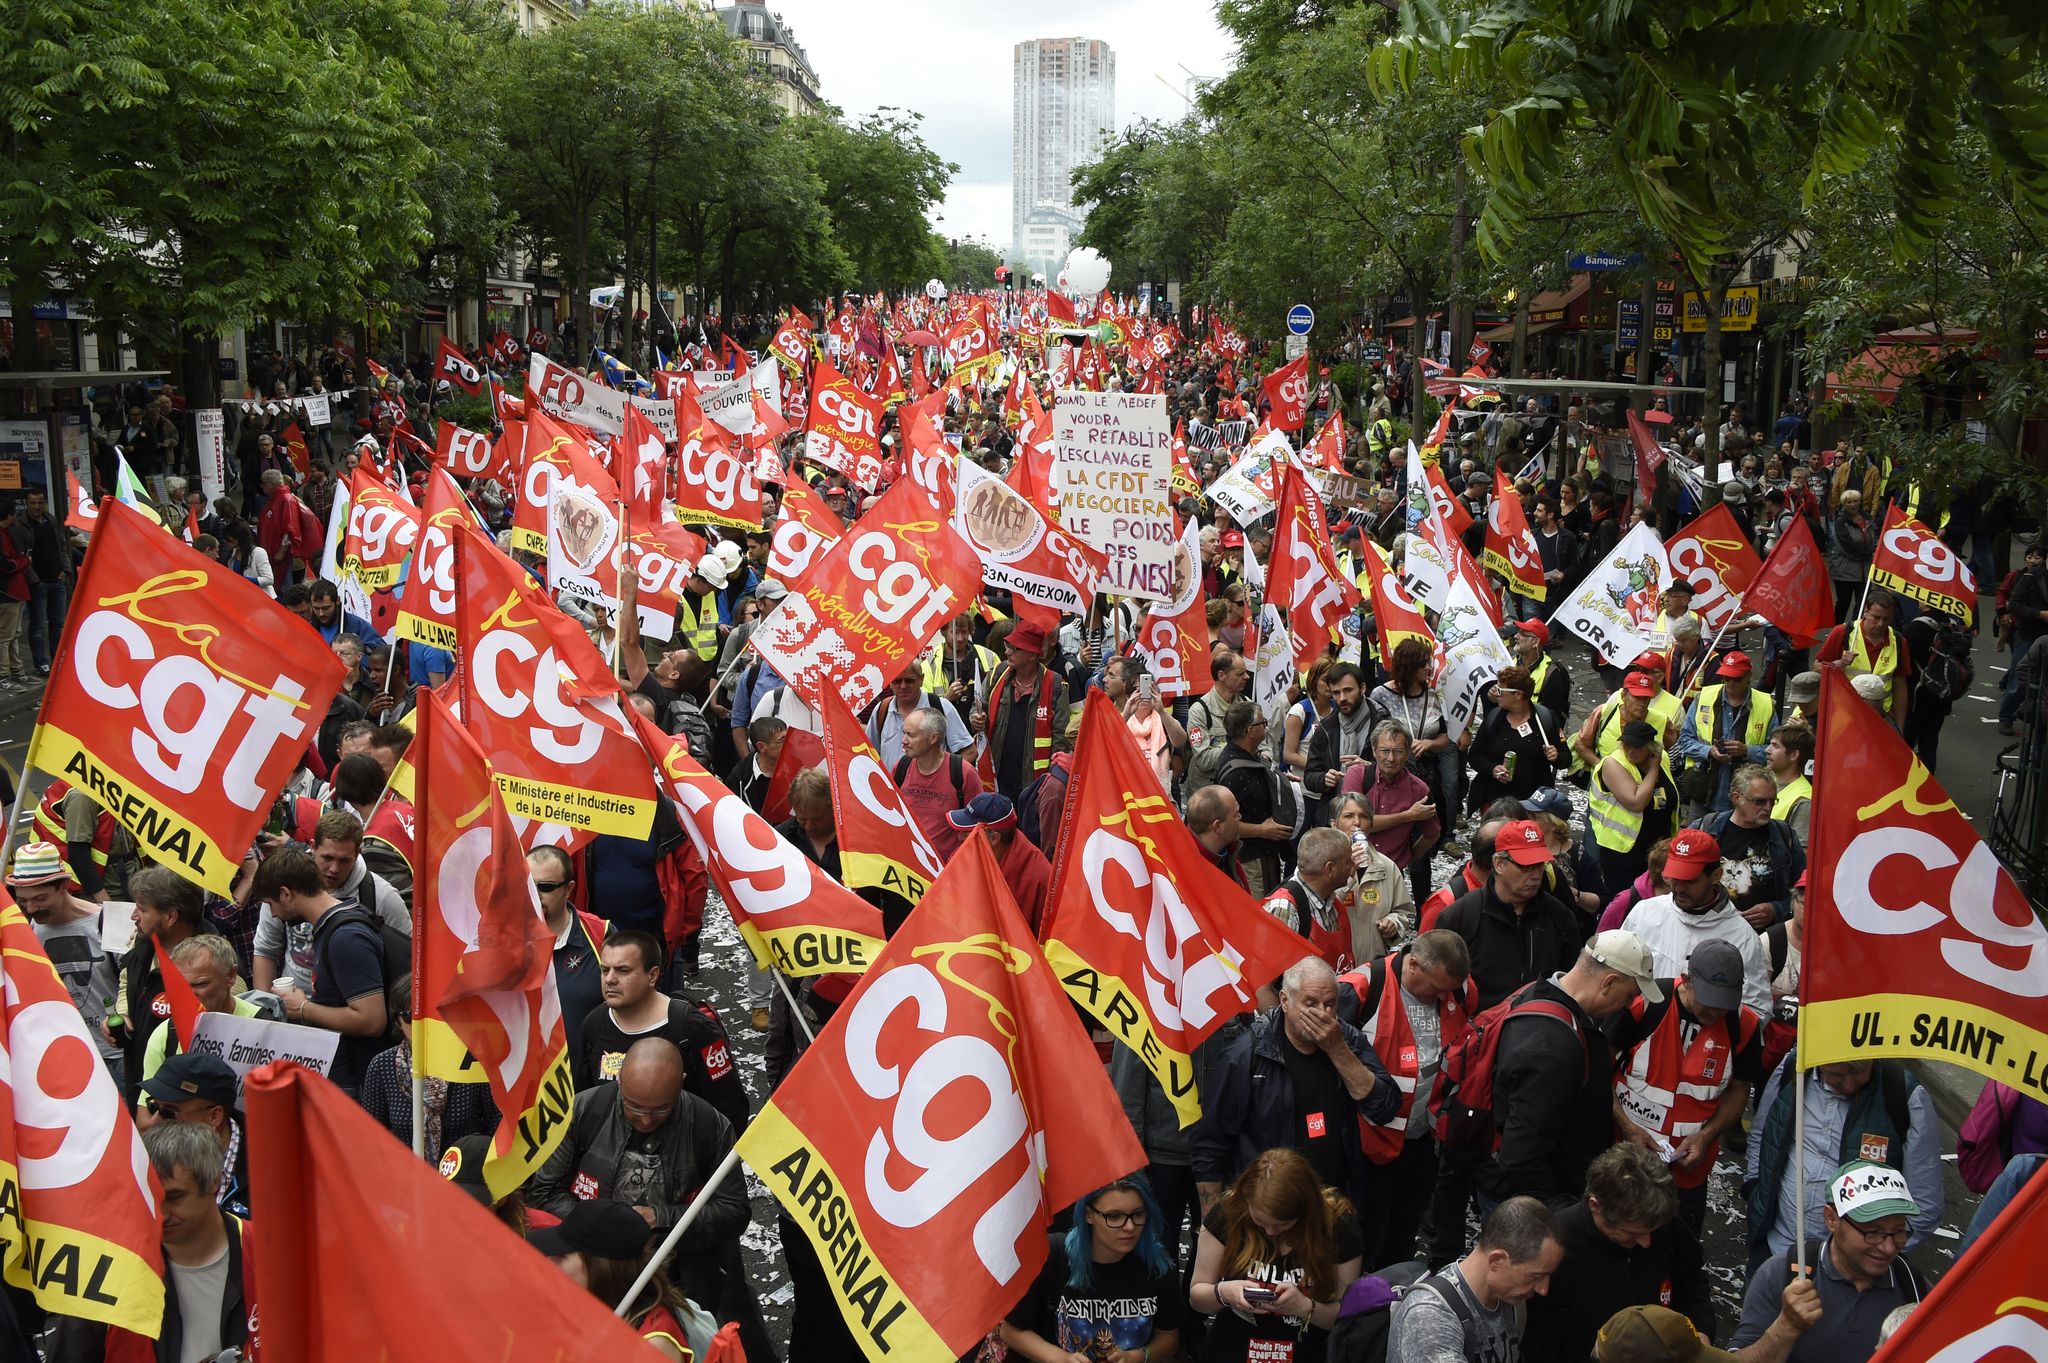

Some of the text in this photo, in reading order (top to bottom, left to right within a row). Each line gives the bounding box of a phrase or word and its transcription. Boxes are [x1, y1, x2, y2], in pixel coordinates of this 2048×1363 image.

[1657, 304, 1671, 314] 47
[1655, 328, 1669, 338] 83
[444, 355, 480, 384] FO
[539, 362, 585, 407] FO
[817, 389, 877, 437] cgt
[1094, 396, 1108, 408] LE
[1117, 396, 1157, 409] MEDEF
[1070, 413, 1120, 427] VOUDRA
[447, 426, 492, 473] FO
[814, 422, 876, 451] métallurgie
[1066, 469, 1149, 495] LA CFDT
[1070, 518, 1091, 535] LE
[610, 541, 697, 597] cgt
[848, 531, 954, 641] cgt
[1669, 537, 1745, 631] cgt
[1872, 569, 1967, 619] UL FLERS
[412, 618, 427, 640] UL
[805, 583, 906, 662] métallurgie
[74, 609, 306, 813] cgt
[509, 780, 562, 804] Ministère
[564, 789, 574, 804] et
[577, 792, 636, 816] Industries
[63, 750, 211, 878] ARSENAL
[516, 800, 591, 826] de la Défense
[1850, 1011, 1884, 1048] UL
[1909, 1012, 2006, 1065] SAINT
[705, 1046, 731, 1068] cgt
[1401, 1051, 1416, 1062] cgt
[1309, 1118, 1324, 1130] cgt
[1860, 1142, 1889, 1160] cgt
[771, 1145, 908, 1356] ARSENAL
[1248, 1349, 1287, 1360] ENFER
[1249, 1339, 1293, 1352] Paradis Fiscal
